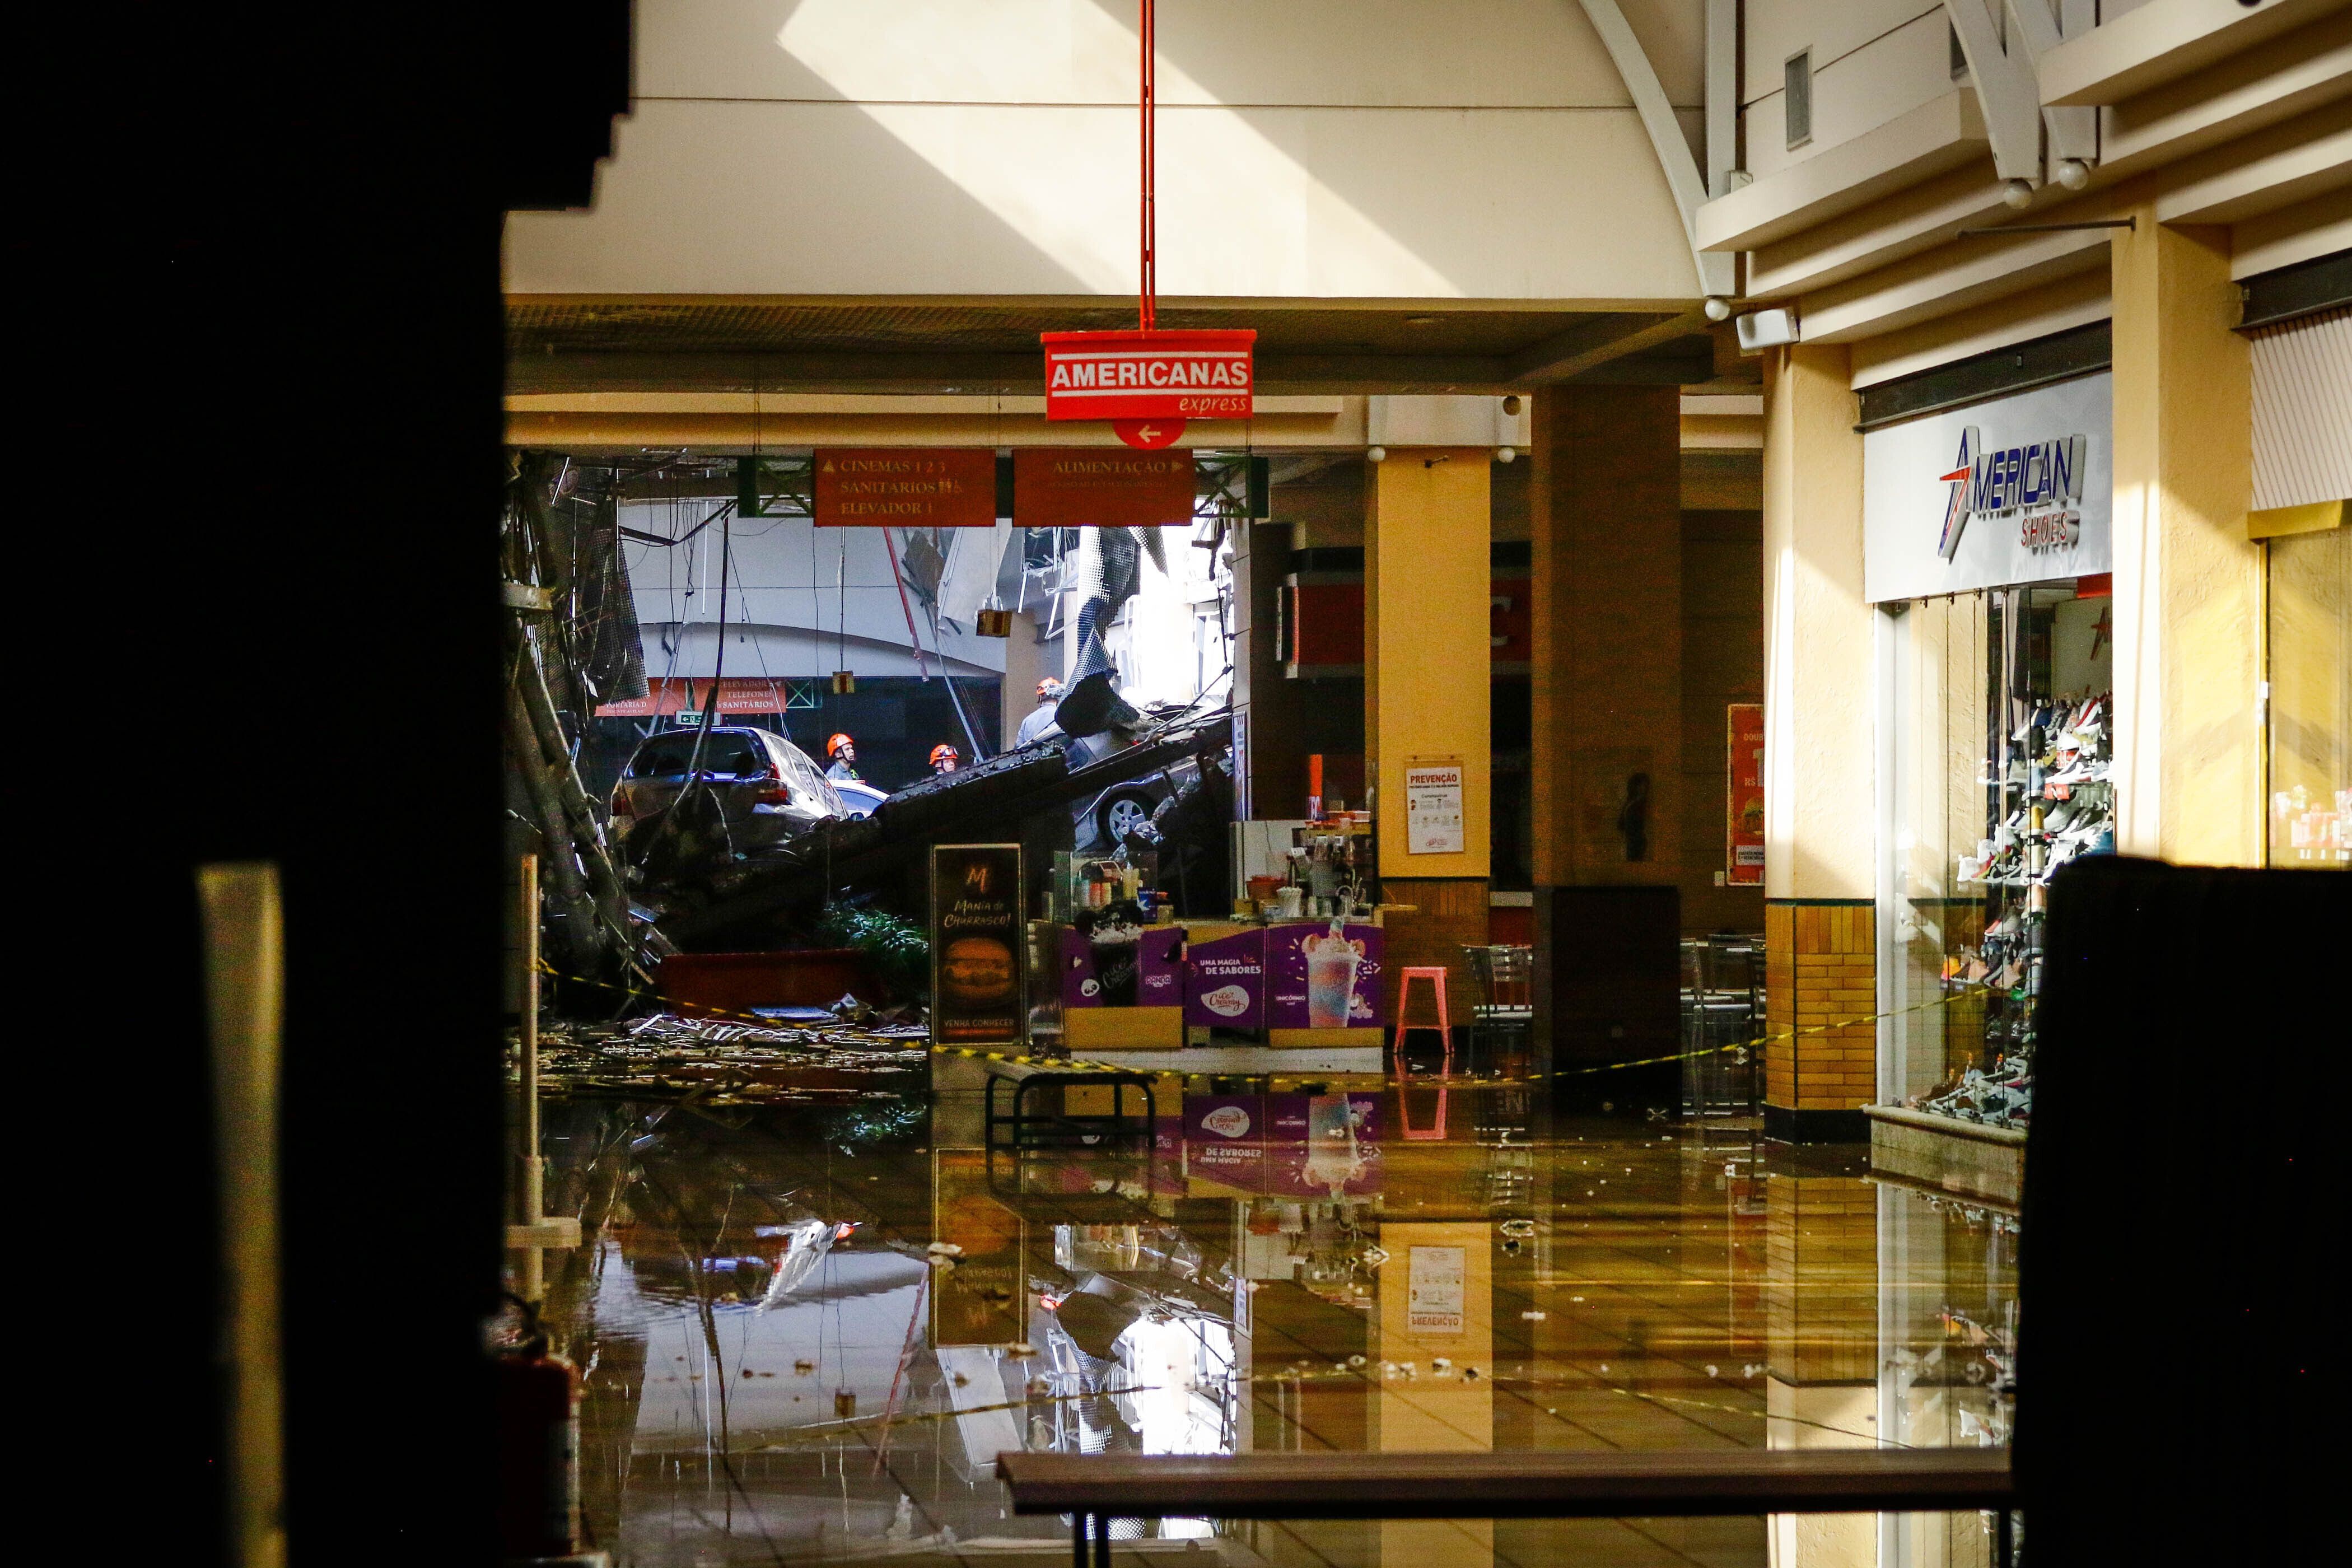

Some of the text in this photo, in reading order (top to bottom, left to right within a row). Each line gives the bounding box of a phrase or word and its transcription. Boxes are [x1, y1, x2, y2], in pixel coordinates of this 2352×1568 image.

[1051, 362, 1249, 388] AMERICANAS
[1179, 396, 1247, 414] express
[841, 460, 911, 472] CINEMAS
[926, 461, 934, 473] 2
[938, 461, 946, 473] 3
[1053, 460, 1166, 475] ALIMENTAÇÃO
[1938, 427, 2076, 556] AMERICAN
[841, 502, 922, 514] ELEVADOR
[2021, 512, 2070, 547] SHOES
[722, 700, 773, 708] SANITÁRIOS
[1411, 773, 1457, 784] PREVENÇÃO
[1219, 965, 1261, 974] SABORES
